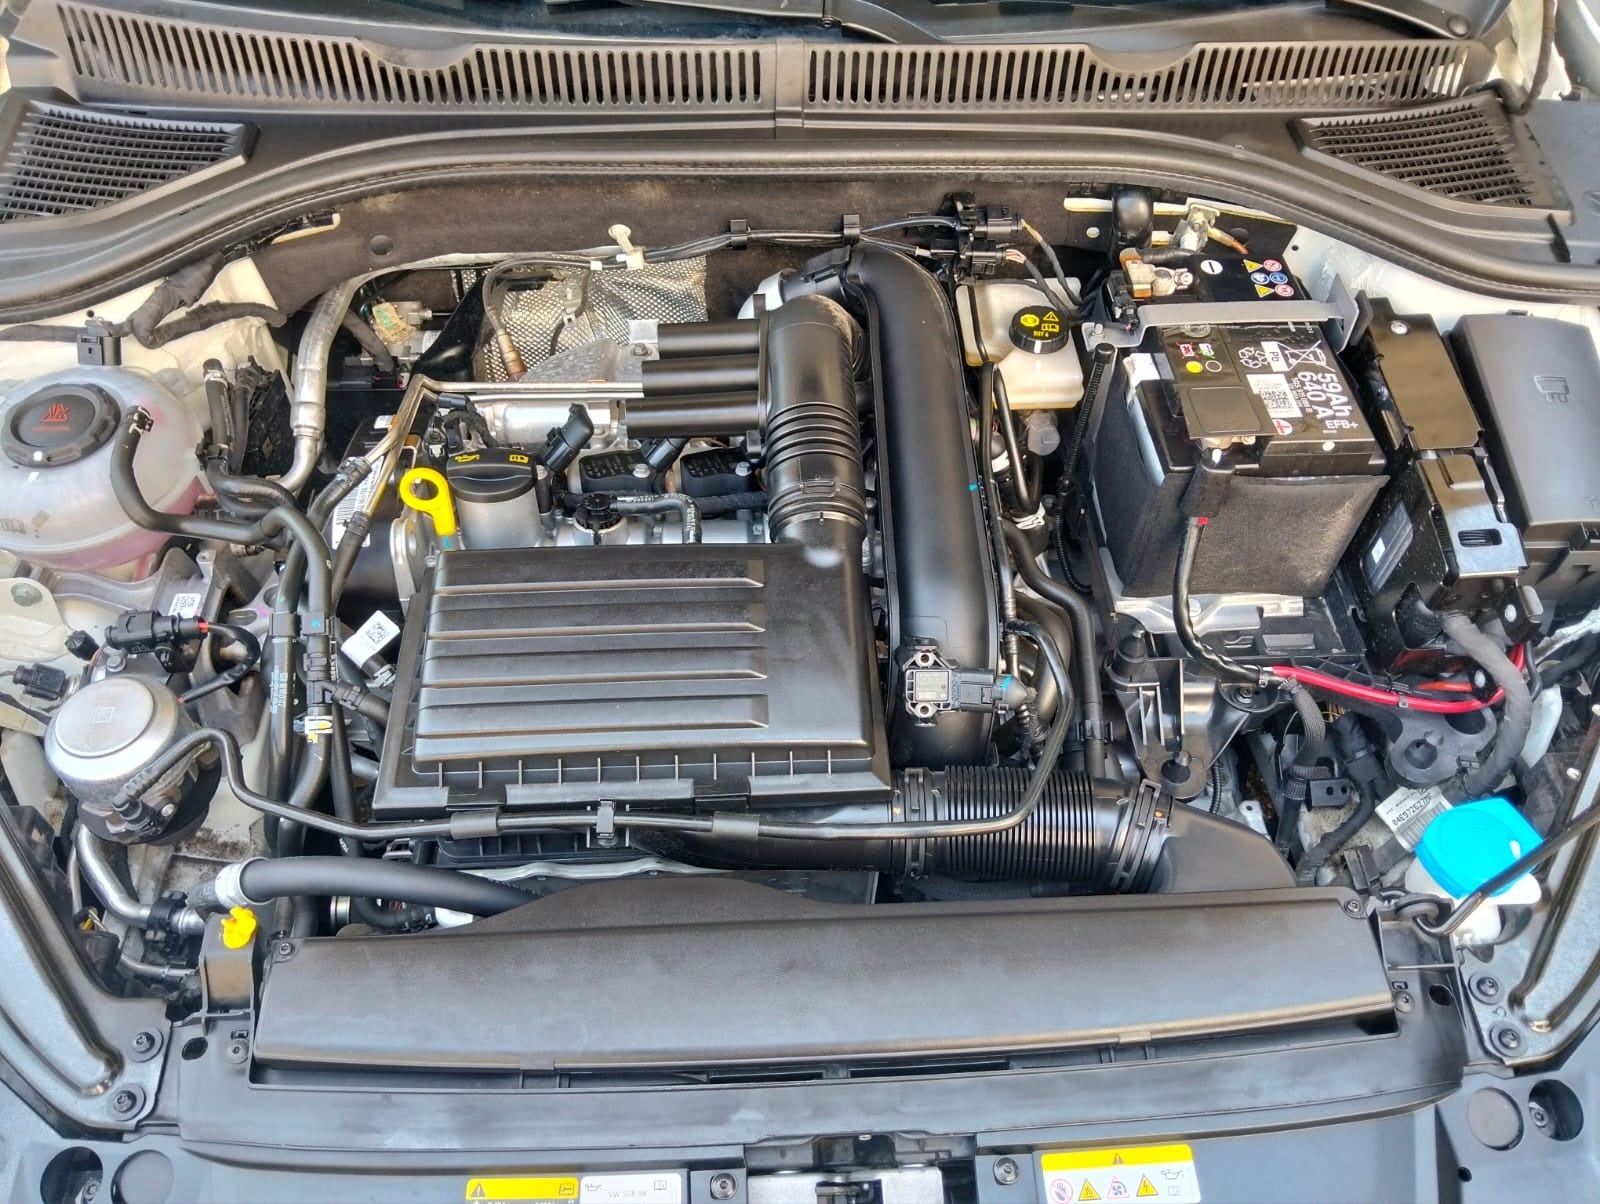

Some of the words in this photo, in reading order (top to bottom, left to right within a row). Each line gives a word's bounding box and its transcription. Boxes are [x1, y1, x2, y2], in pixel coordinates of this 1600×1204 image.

[1268, 351, 1280, 362] Pb
[1297, 371, 1327, 401] 640
[1312, 405, 1334, 420] A
[1318, 372, 1353, 417] 59Ah
